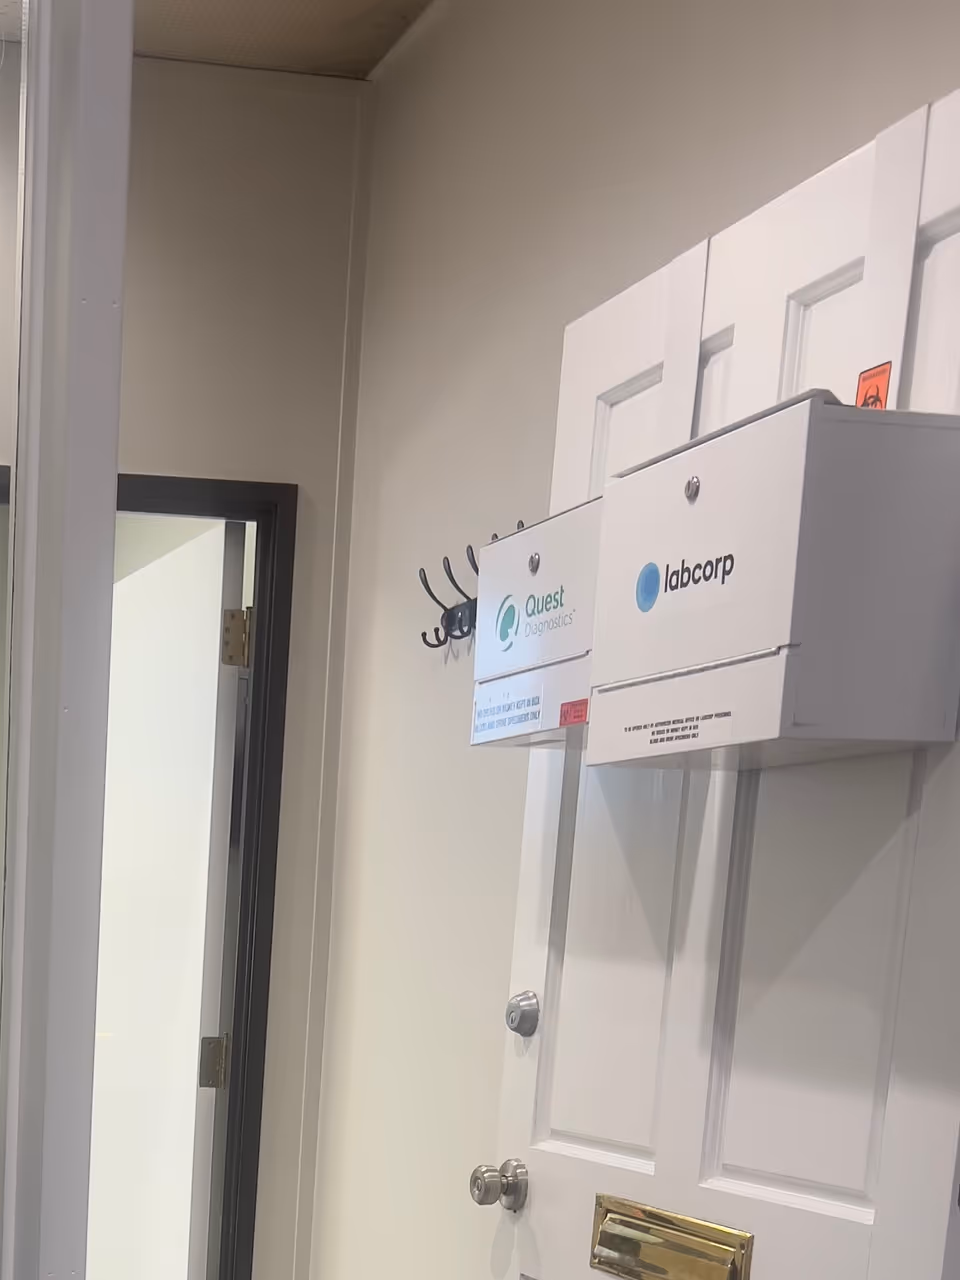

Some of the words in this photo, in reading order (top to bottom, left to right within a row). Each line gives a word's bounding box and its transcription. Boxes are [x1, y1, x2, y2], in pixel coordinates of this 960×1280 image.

[664, 553, 735, 593] labcorp
[525, 584, 565, 618] Quest
[525, 612, 573, 638] Diagnostics
